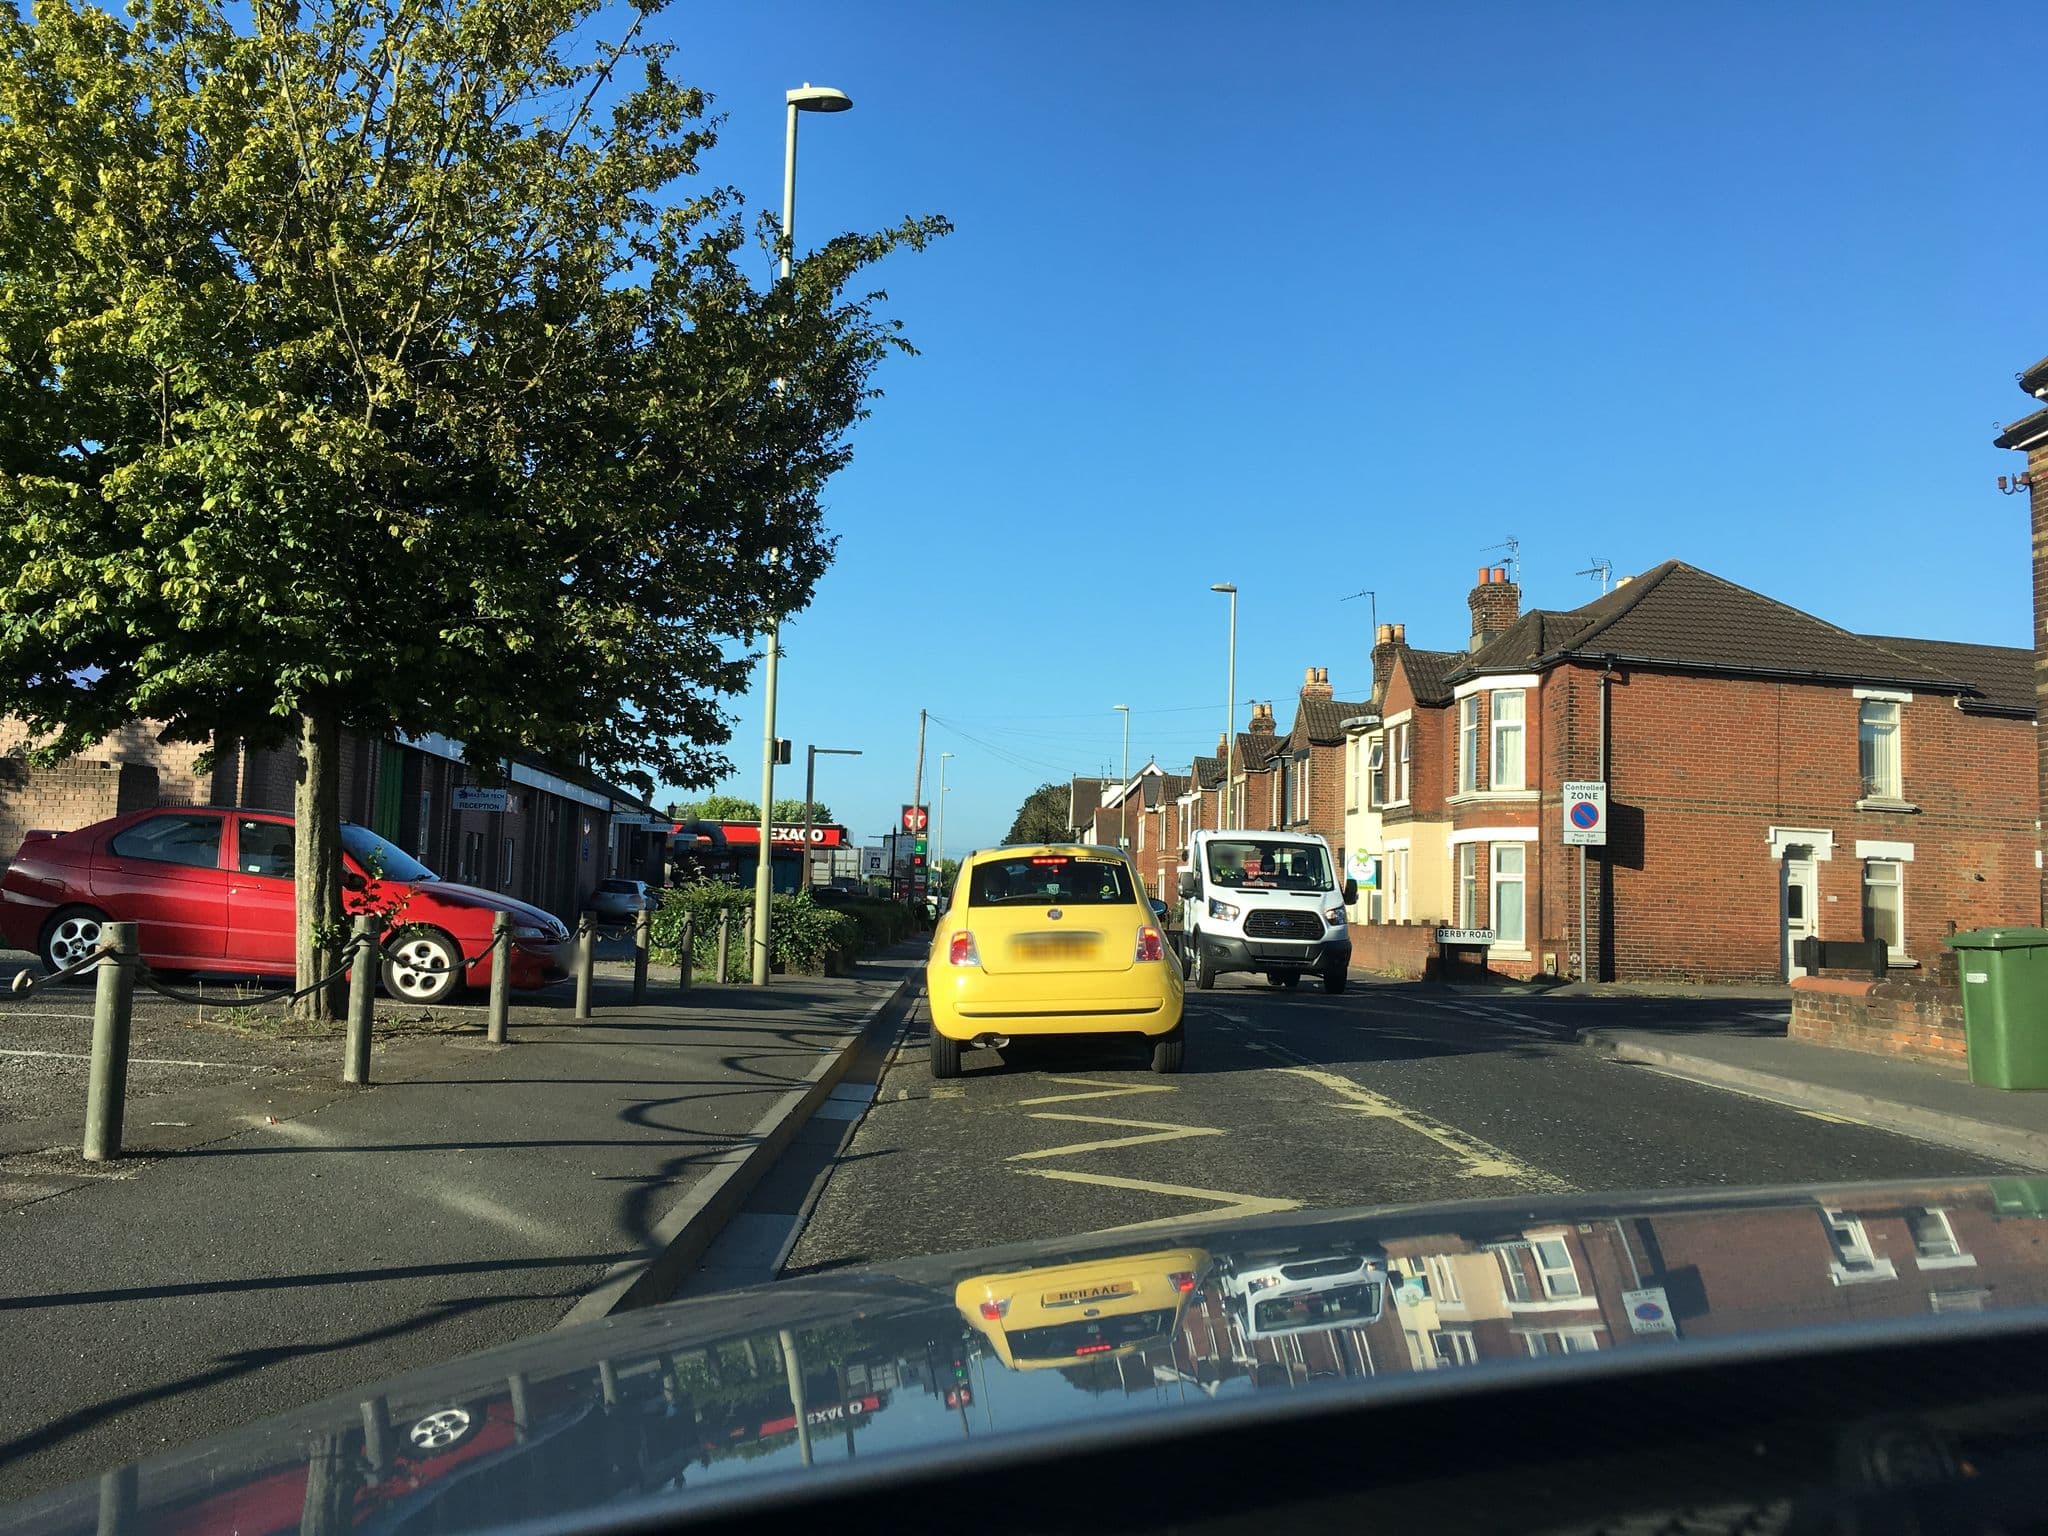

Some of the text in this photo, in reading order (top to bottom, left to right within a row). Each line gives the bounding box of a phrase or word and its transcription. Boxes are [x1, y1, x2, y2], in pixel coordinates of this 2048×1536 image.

[1571, 792, 1599, 800] ZONE
[459, 802, 500, 810] RECEPTION
[1438, 930, 1493, 939] DERBY ROAD
